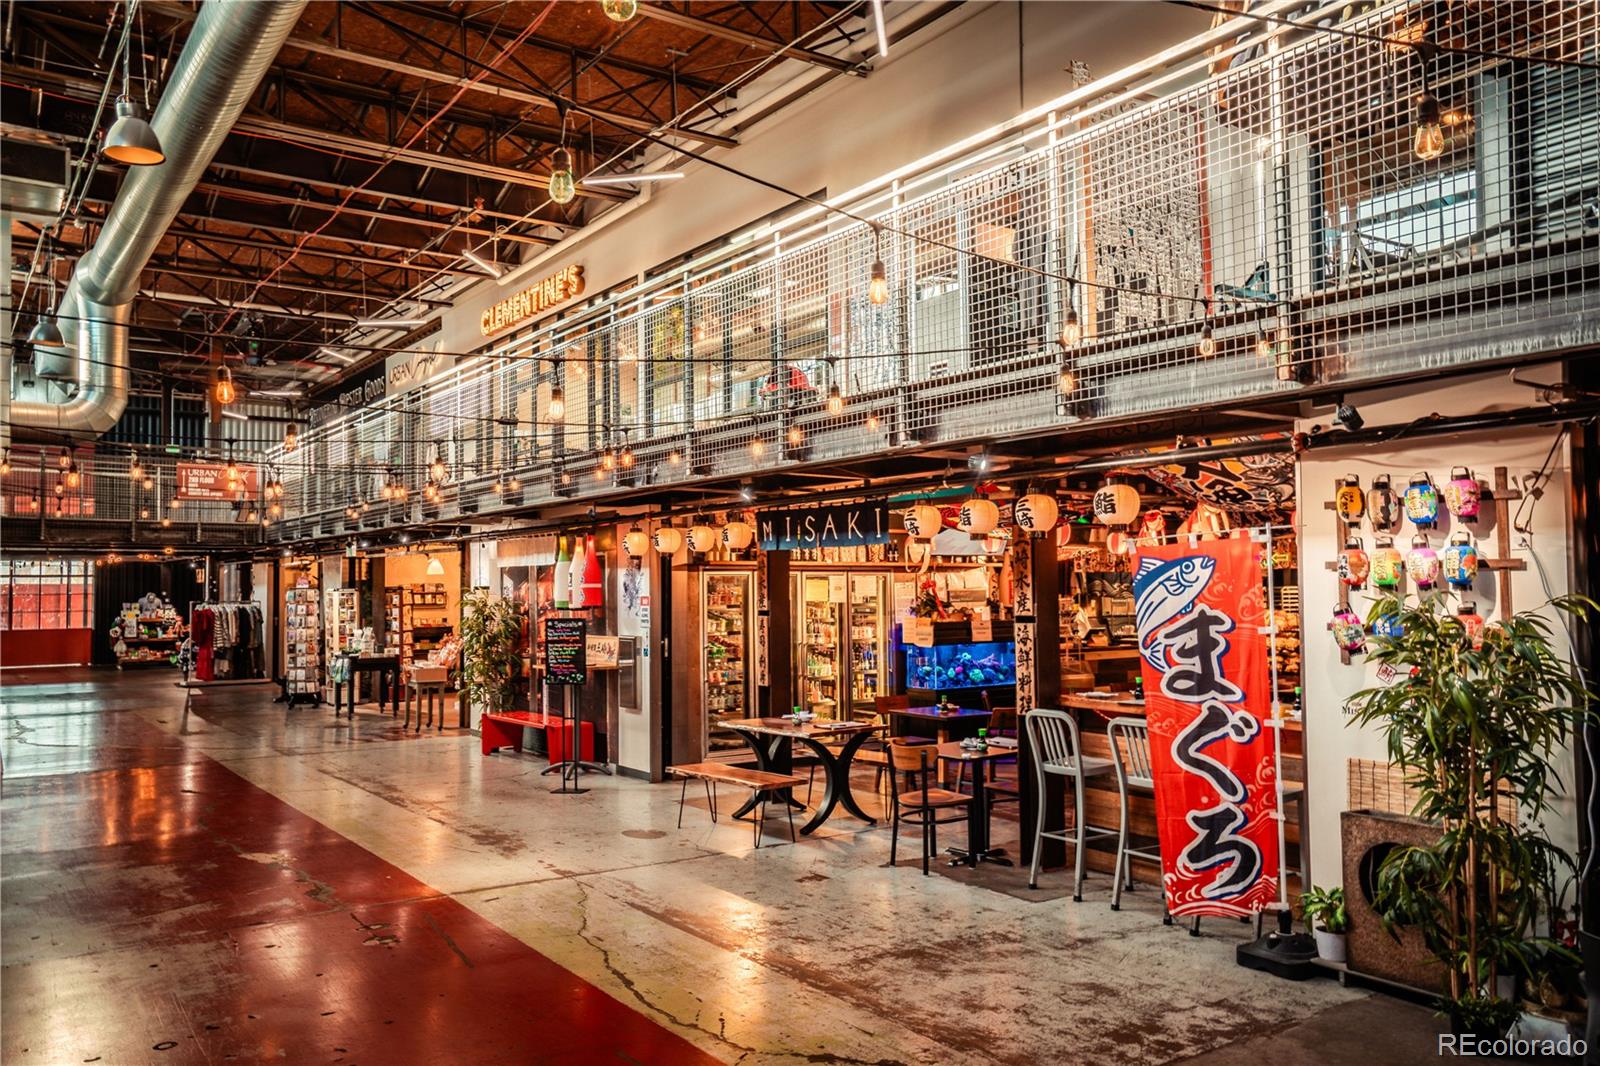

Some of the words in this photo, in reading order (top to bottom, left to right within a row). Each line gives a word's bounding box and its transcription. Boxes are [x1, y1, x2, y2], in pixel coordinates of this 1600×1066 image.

[480, 264, 585, 336] CLEMENTINE'S
[188, 469, 218, 477] URBAN
[762, 507, 882, 542] MISAKI
[1161, 604, 1261, 899] まぐろ
